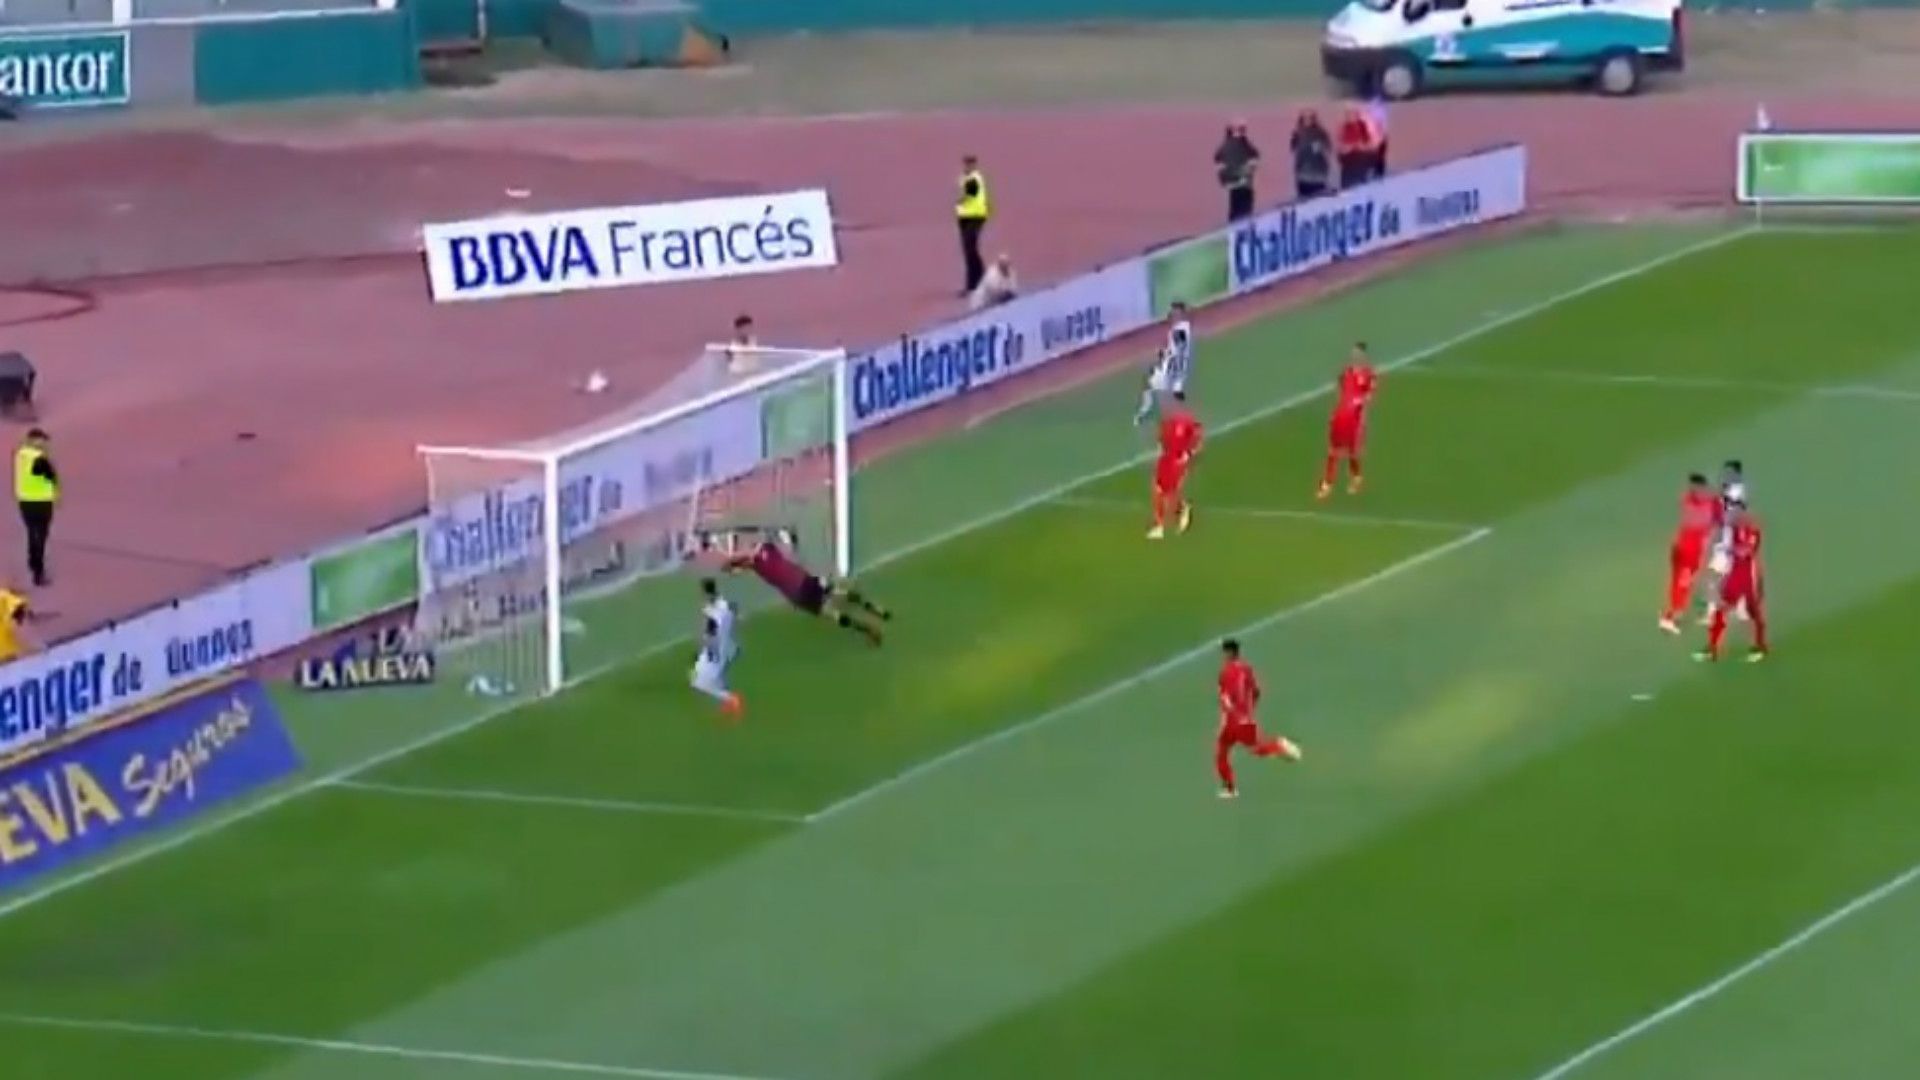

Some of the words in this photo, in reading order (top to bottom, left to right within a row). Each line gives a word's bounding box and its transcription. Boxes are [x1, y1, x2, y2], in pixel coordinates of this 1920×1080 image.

[0, 51, 115, 96] ancor
[449, 226, 599, 291] BBVA
[608, 204, 814, 277] Francés
[1233, 200, 1374, 284] Challenger
[852, 324, 998, 419] Challenger
[112, 651, 142, 696] de
